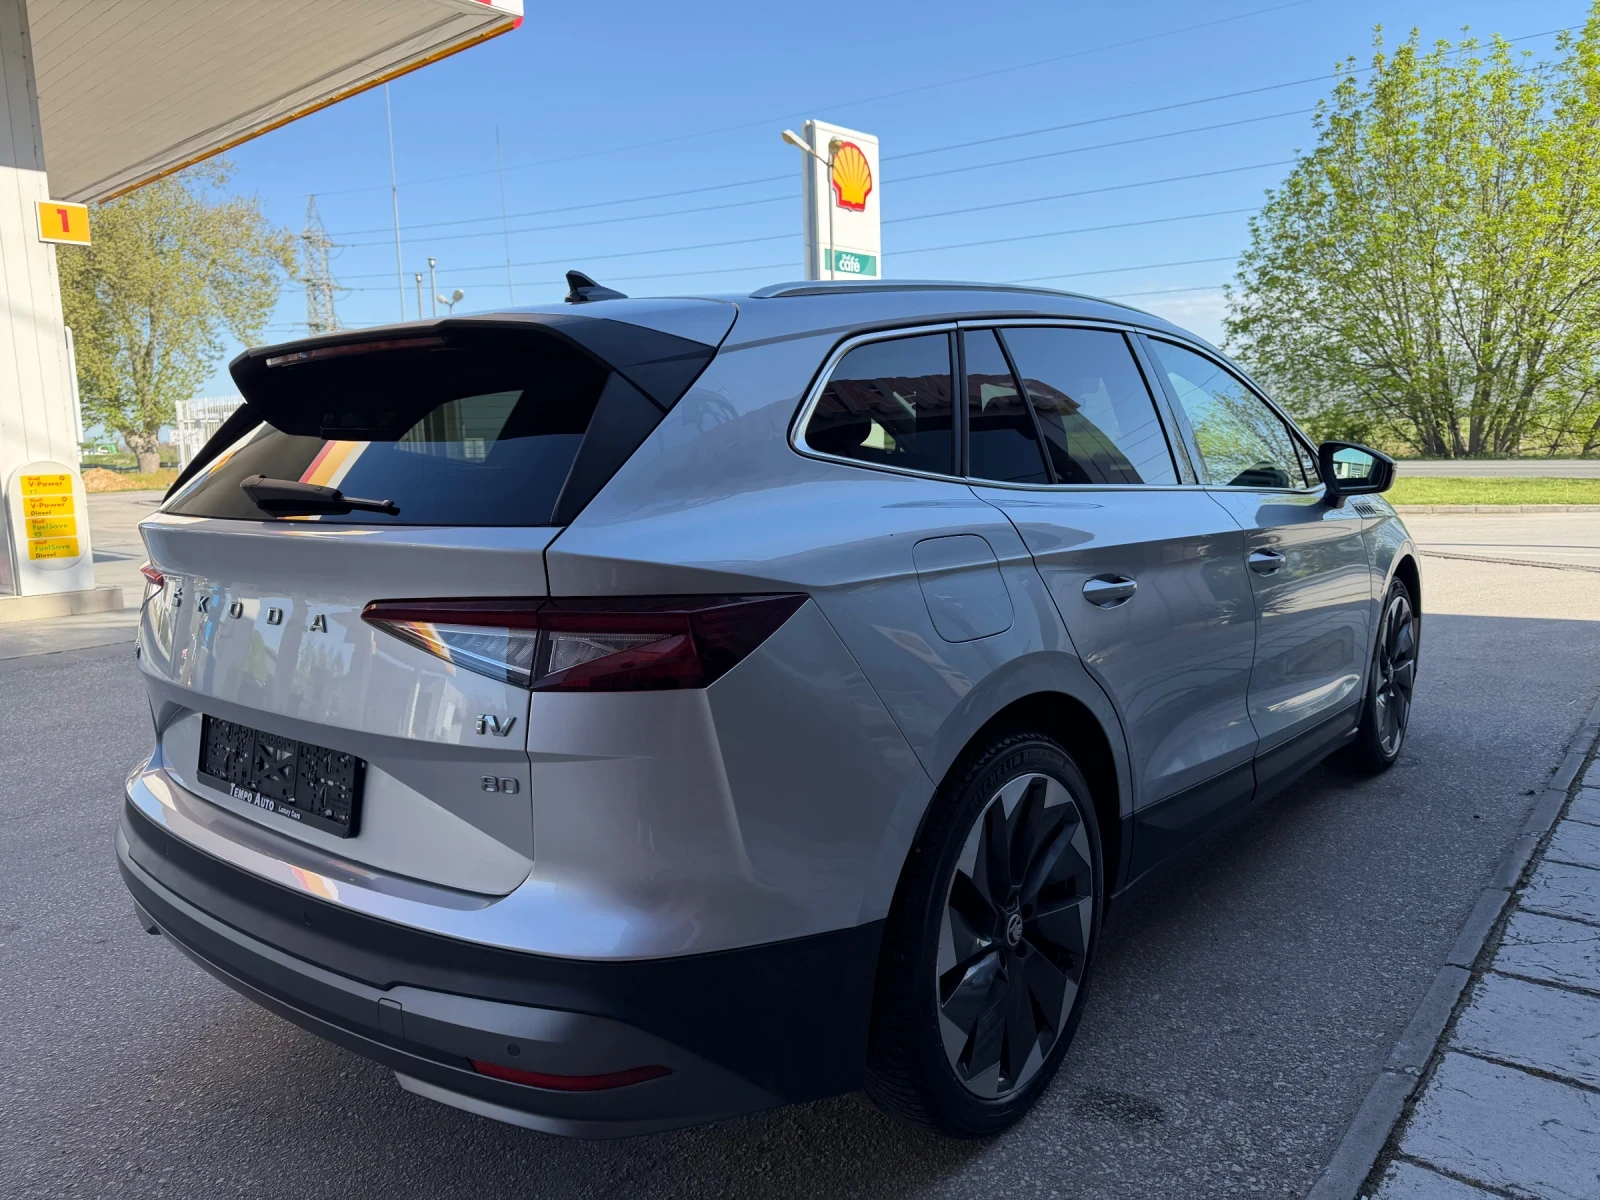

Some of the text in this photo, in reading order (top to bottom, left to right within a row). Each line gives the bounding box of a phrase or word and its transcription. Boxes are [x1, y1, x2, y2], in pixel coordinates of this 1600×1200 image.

[57, 208, 70, 233] 1
[839, 256, 861, 273] café
[476, 713, 517, 737] iV
[481, 774, 520, 795] 80
[969, 753, 1022, 812] MICHELIN
